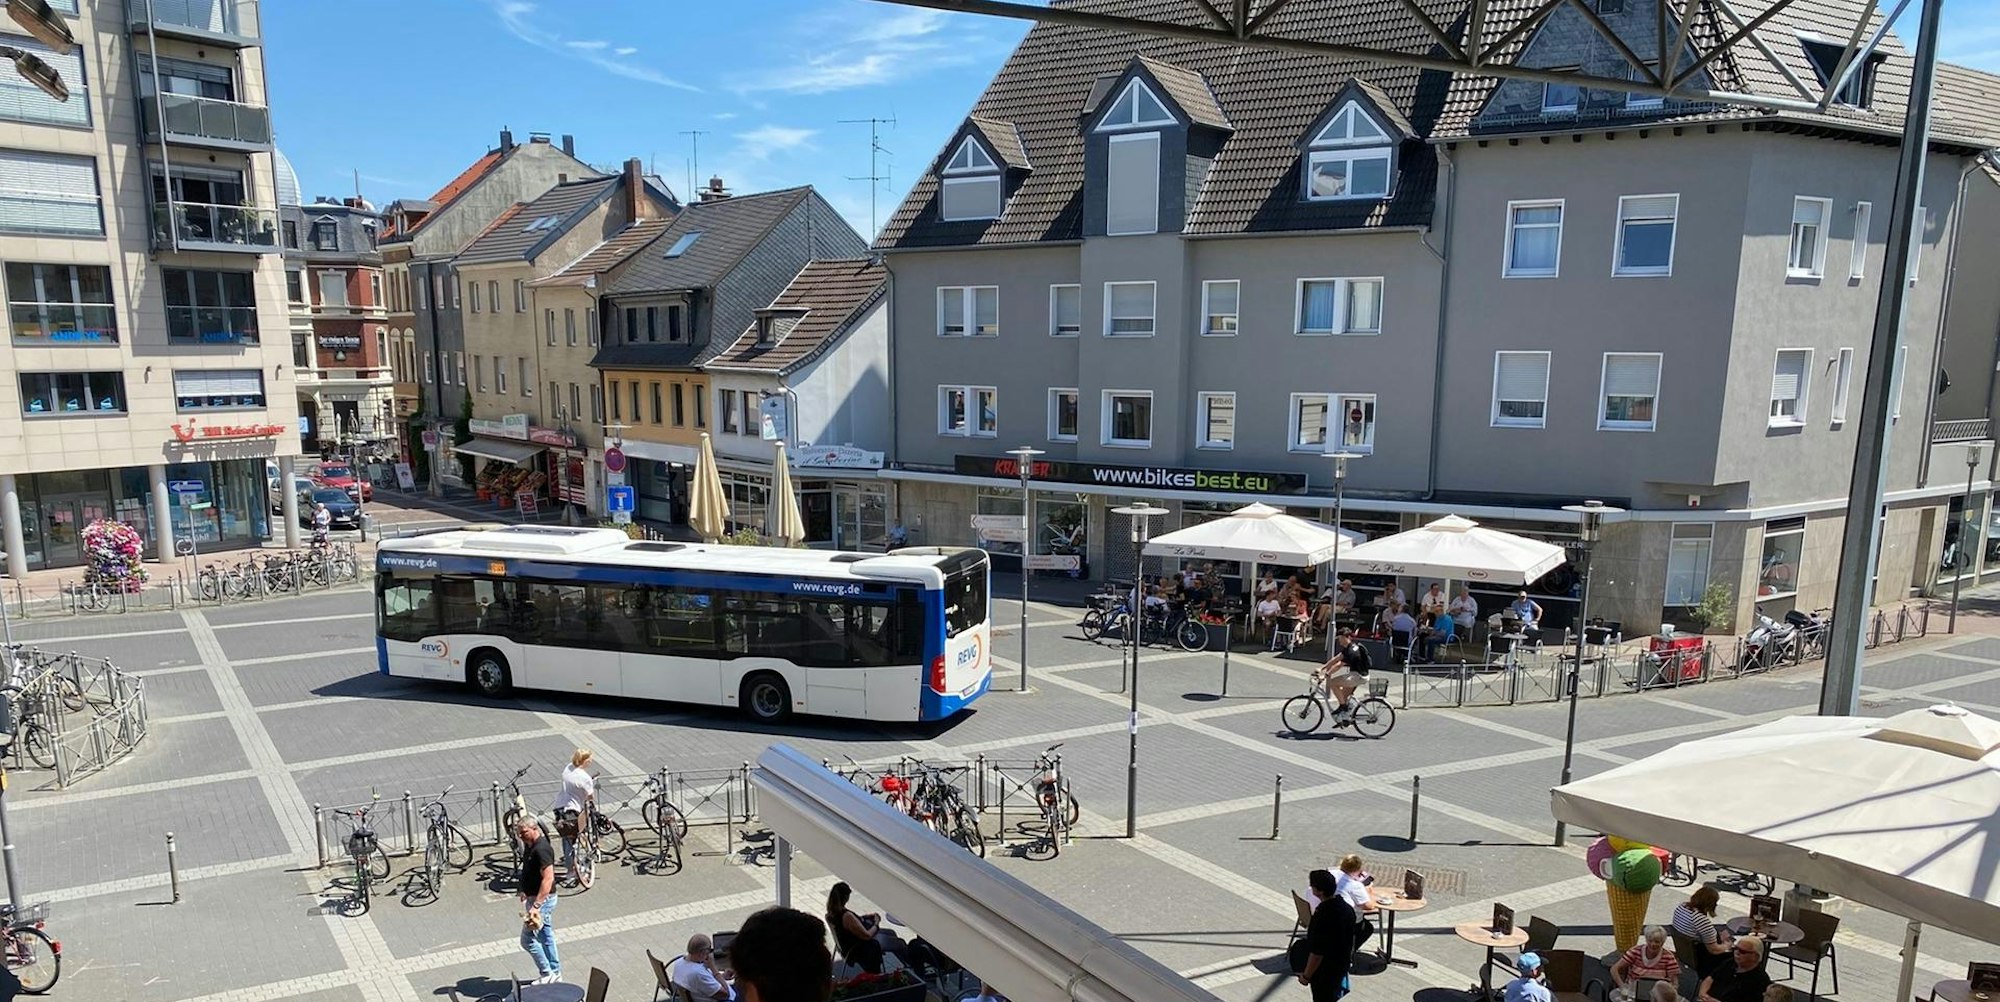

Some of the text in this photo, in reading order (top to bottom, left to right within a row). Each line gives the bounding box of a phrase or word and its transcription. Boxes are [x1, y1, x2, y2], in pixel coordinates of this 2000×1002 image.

[994, 459, 1269, 492] KRAER www.bikesbest.eu
[381, 555, 438, 570] www.revg.de
[792, 581, 861, 597] www.revg.de
[421, 643, 443, 653] REVG
[956, 643, 978, 667] REVG
